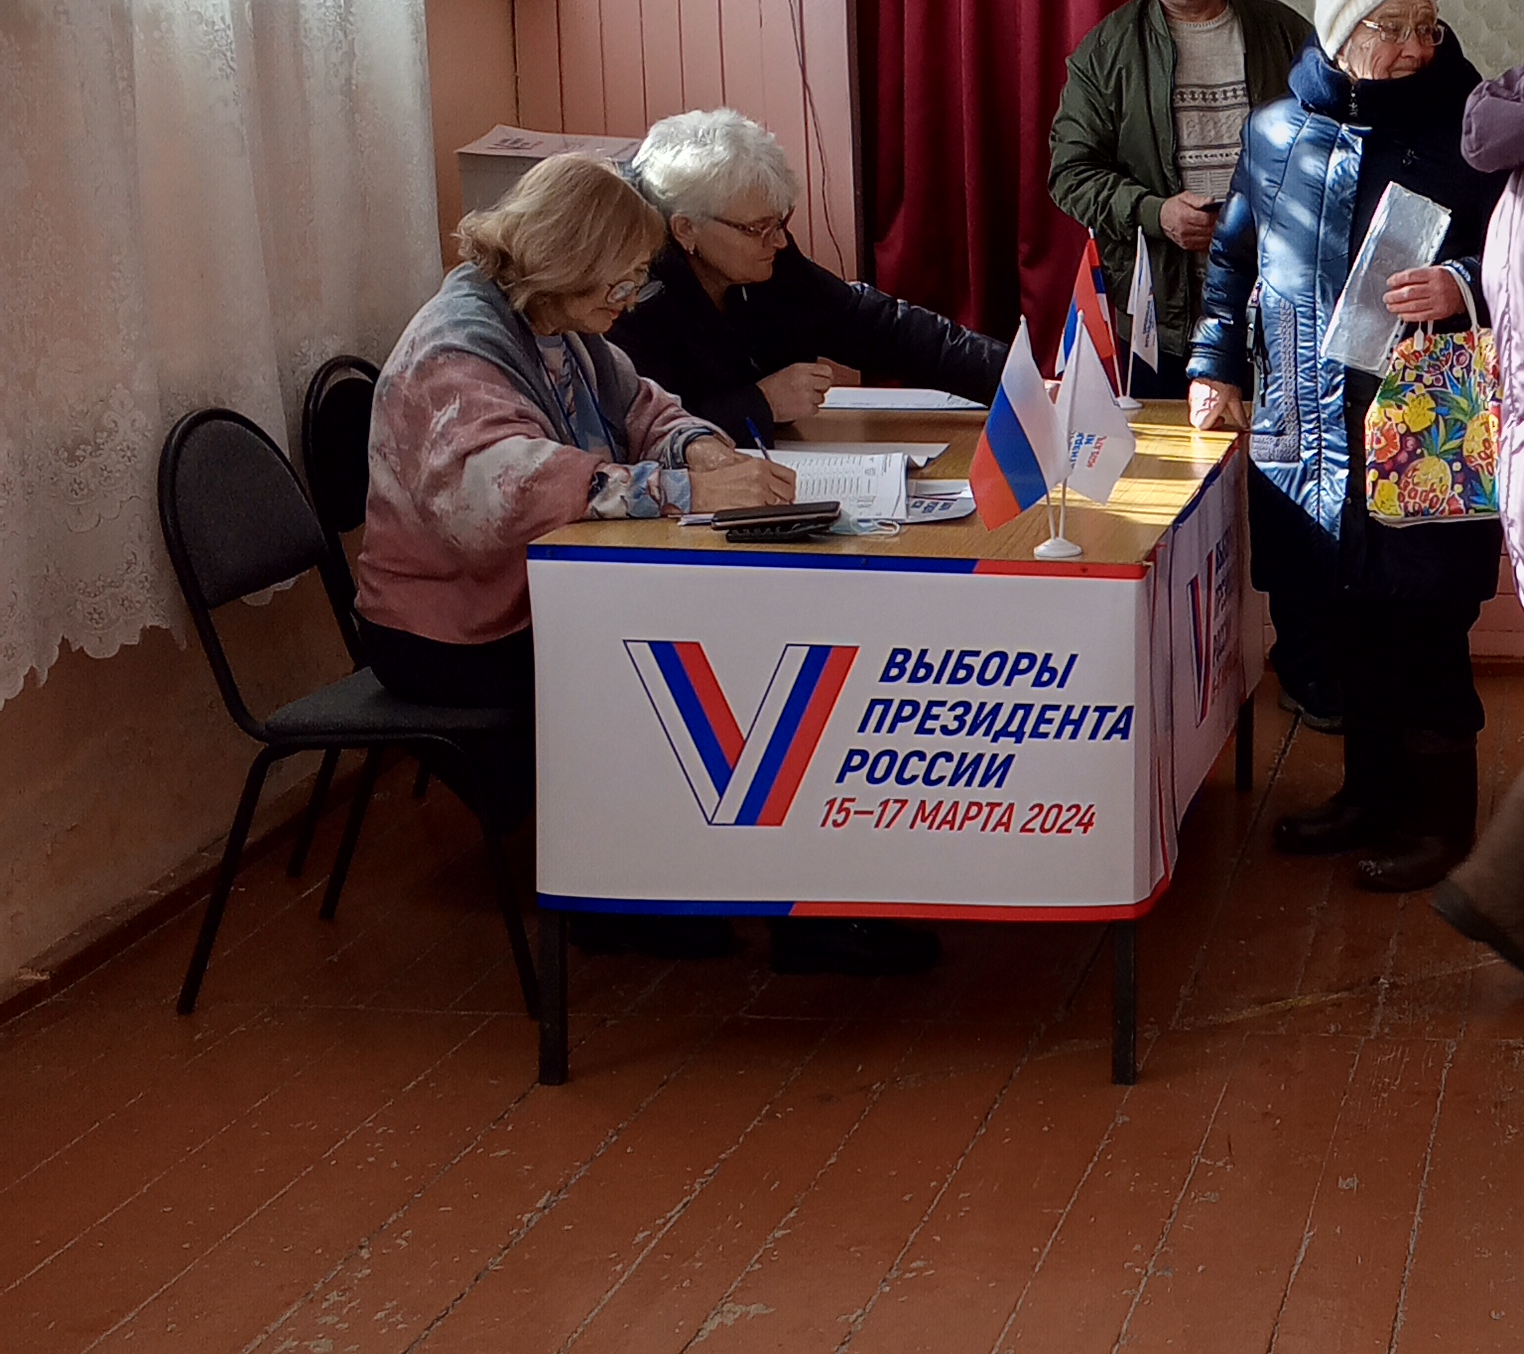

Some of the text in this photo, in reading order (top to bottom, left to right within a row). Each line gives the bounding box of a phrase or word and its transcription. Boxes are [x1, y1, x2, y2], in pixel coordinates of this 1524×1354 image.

[878, 647, 1079, 689] ВЫБОРЫ
[857, 698, 1135, 744] ПРЕЗИДЕНТА
[835, 748, 1016, 789] РОССИИ
[820, 797, 1097, 835] 15-17 МАРТА 2024
